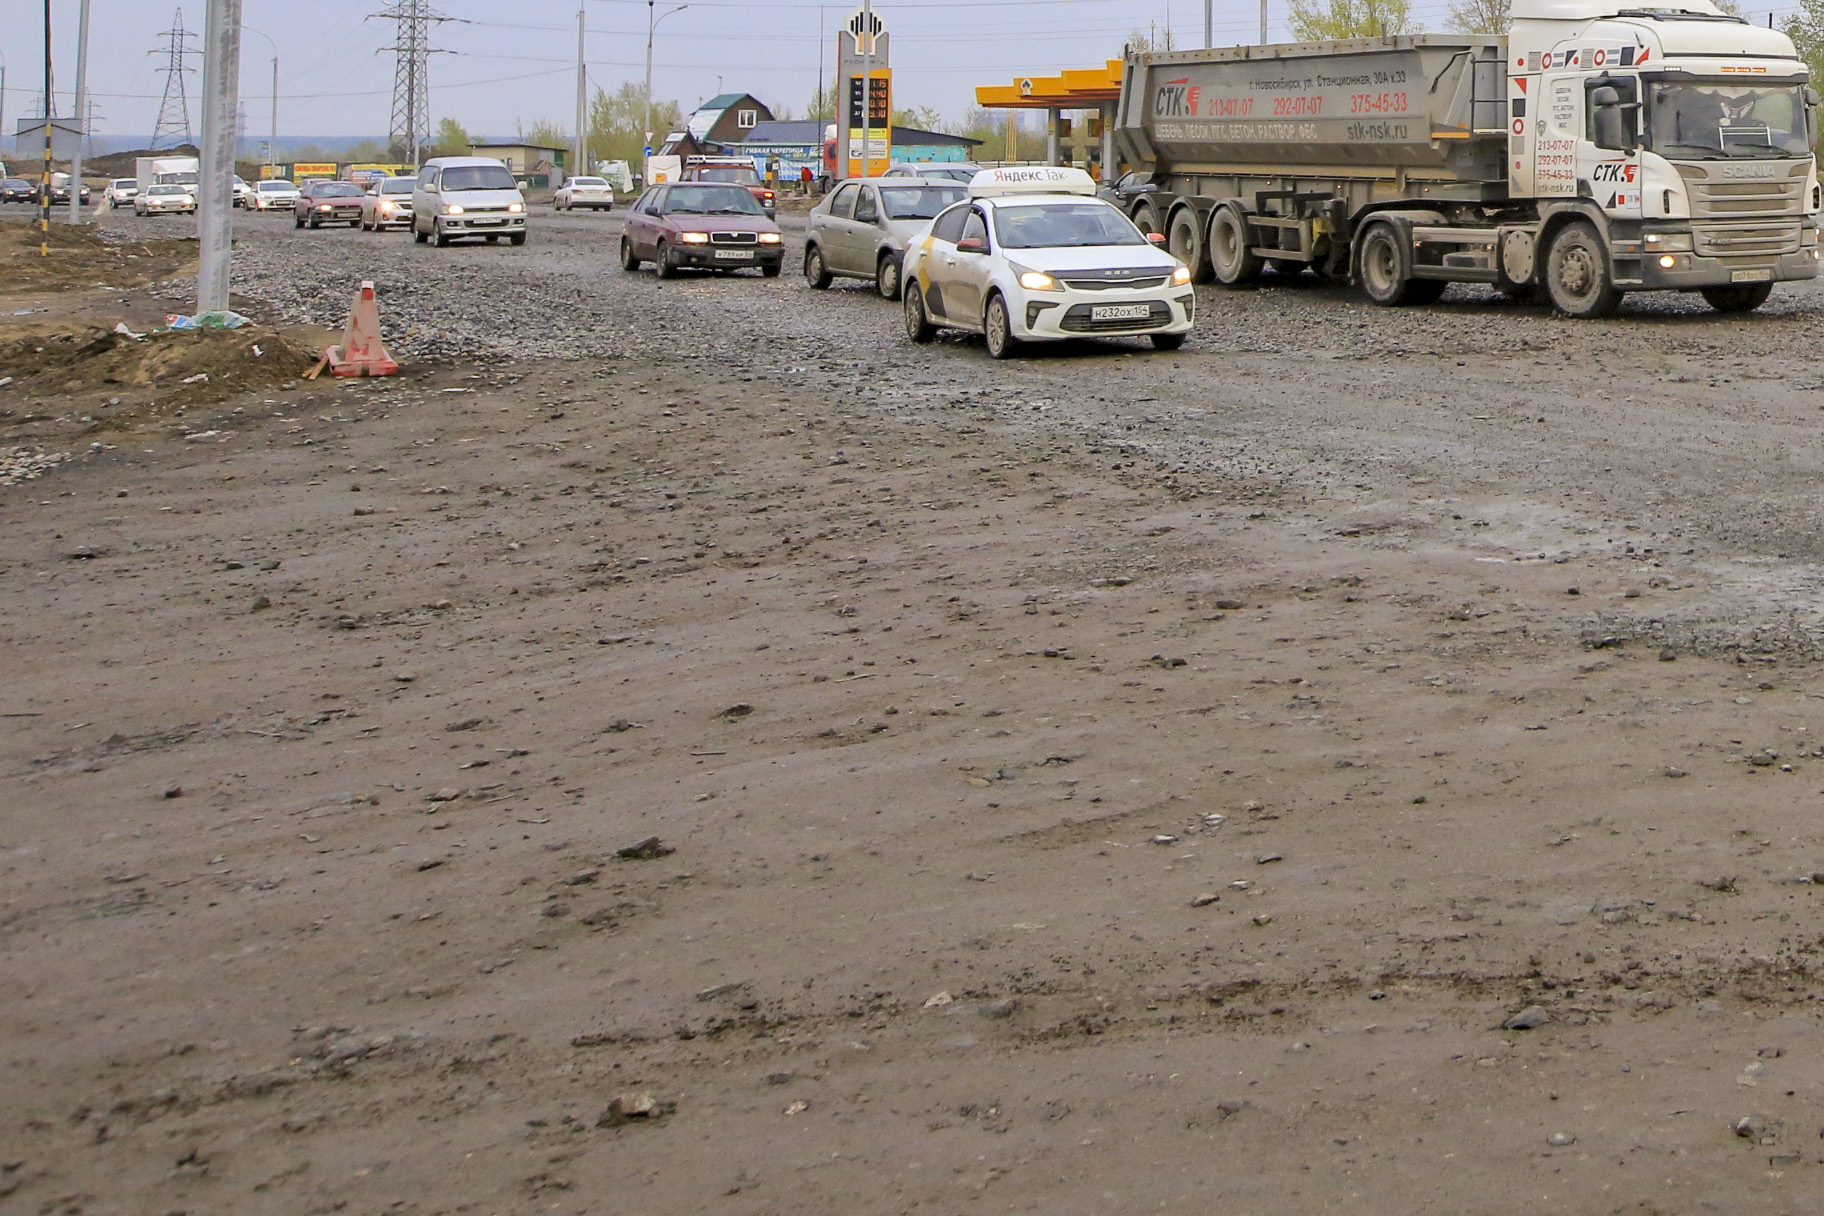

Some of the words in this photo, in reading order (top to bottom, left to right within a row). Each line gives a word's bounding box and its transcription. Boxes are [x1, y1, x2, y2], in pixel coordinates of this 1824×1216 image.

[1208, 98, 1254, 116] 213-07-07
[1273, 96, 1324, 115] 292-07-07
[1351, 92, 1408, 113] 375-45-33
[1347, 121, 1408, 140] stk-nsk.ru
[1538, 140, 1574, 151] 213-07-07
[1538, 155, 1573, 165] 292-07-07
[994, 170, 1042, 182] Яндекс
[1538, 170, 1574, 180] 375-45-33
[1723, 165, 1775, 178] SCANIA
[1537, 184, 1574, 193] stk-nsk.ru
